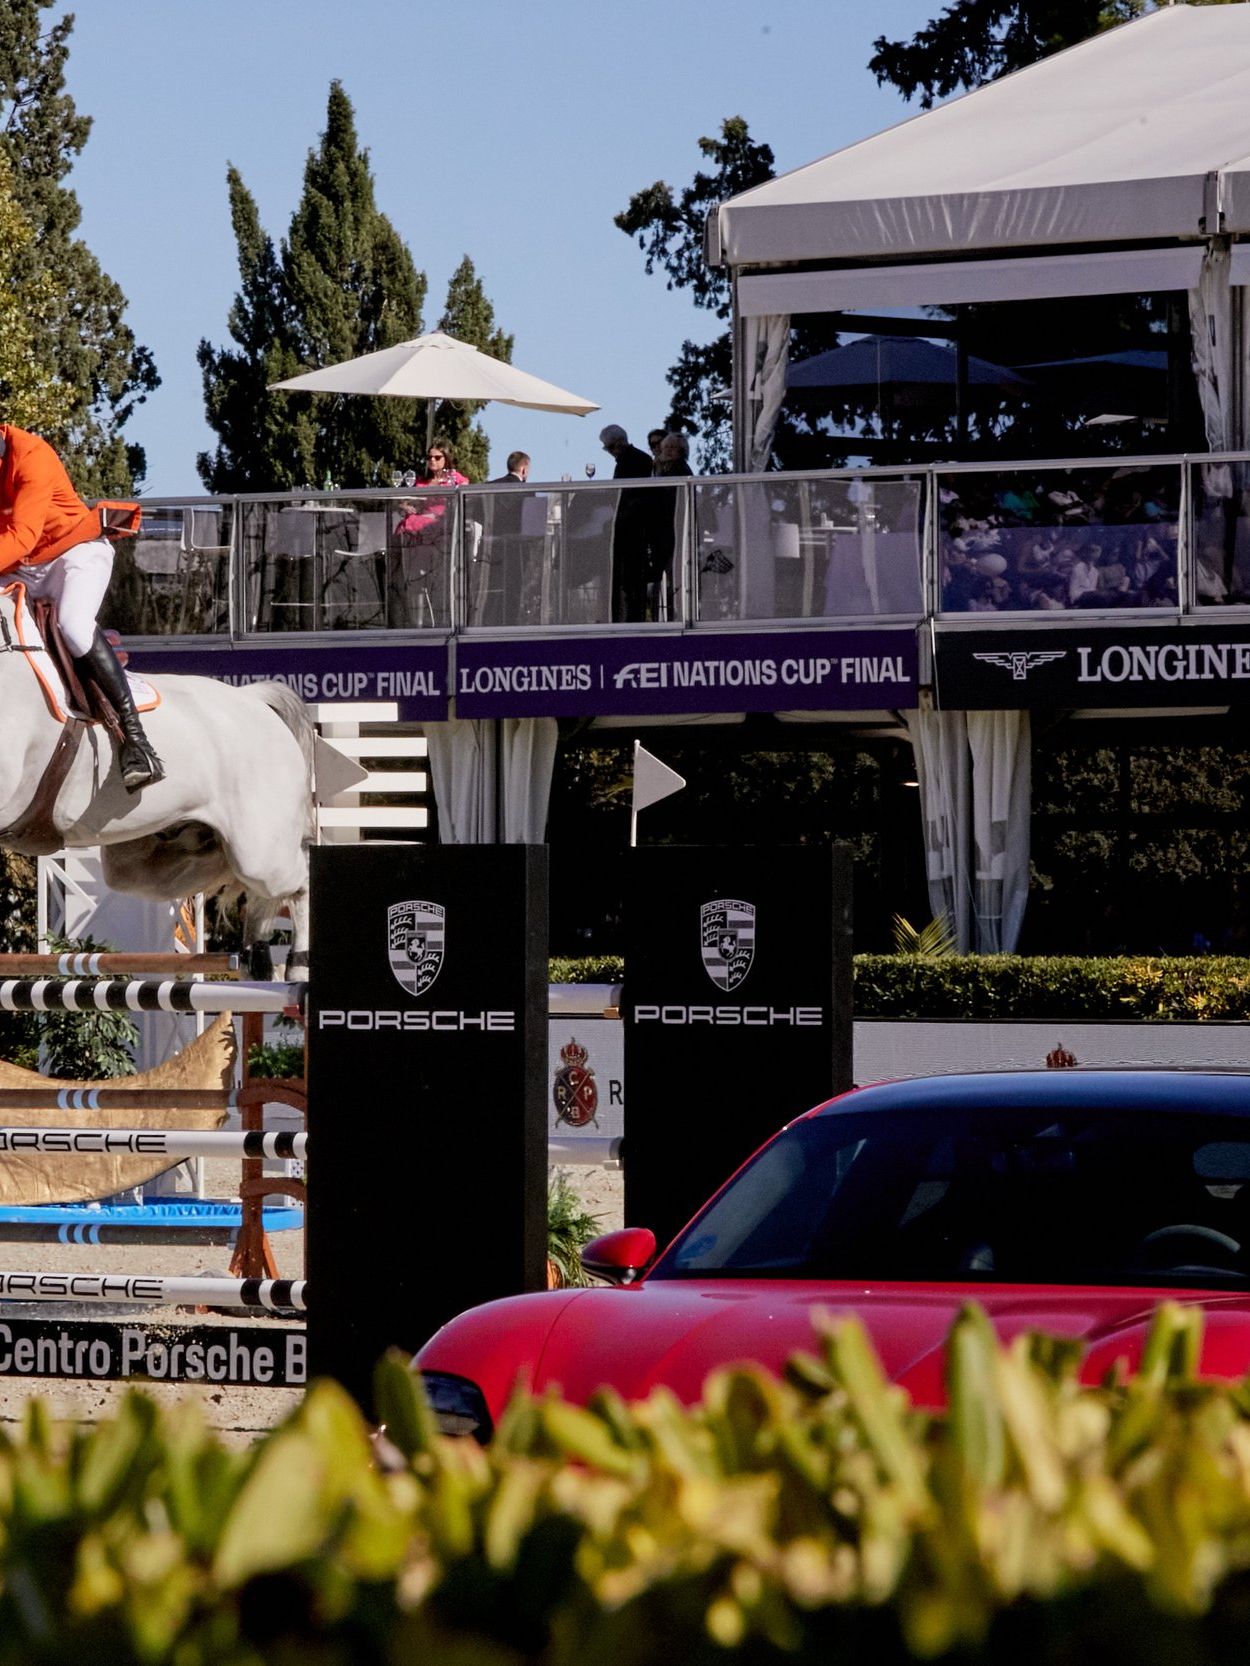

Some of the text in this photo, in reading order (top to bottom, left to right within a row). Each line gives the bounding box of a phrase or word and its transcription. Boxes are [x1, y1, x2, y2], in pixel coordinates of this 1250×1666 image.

[376, 671, 441, 697] FINAL
[459, 664, 592, 693] LONGINES
[673, 659, 778, 687] NATIONS
[841, 656, 911, 684] FINAL
[390, 902, 444, 917] PORSCHE
[702, 901, 755, 915] PORSCHE
[318, 1010, 515, 1031] PORSCHE
[634, 1005, 823, 1026] PORSCHE
[608, 1079, 623, 1105] R
[121, 1327, 275, 1384] Porsche
